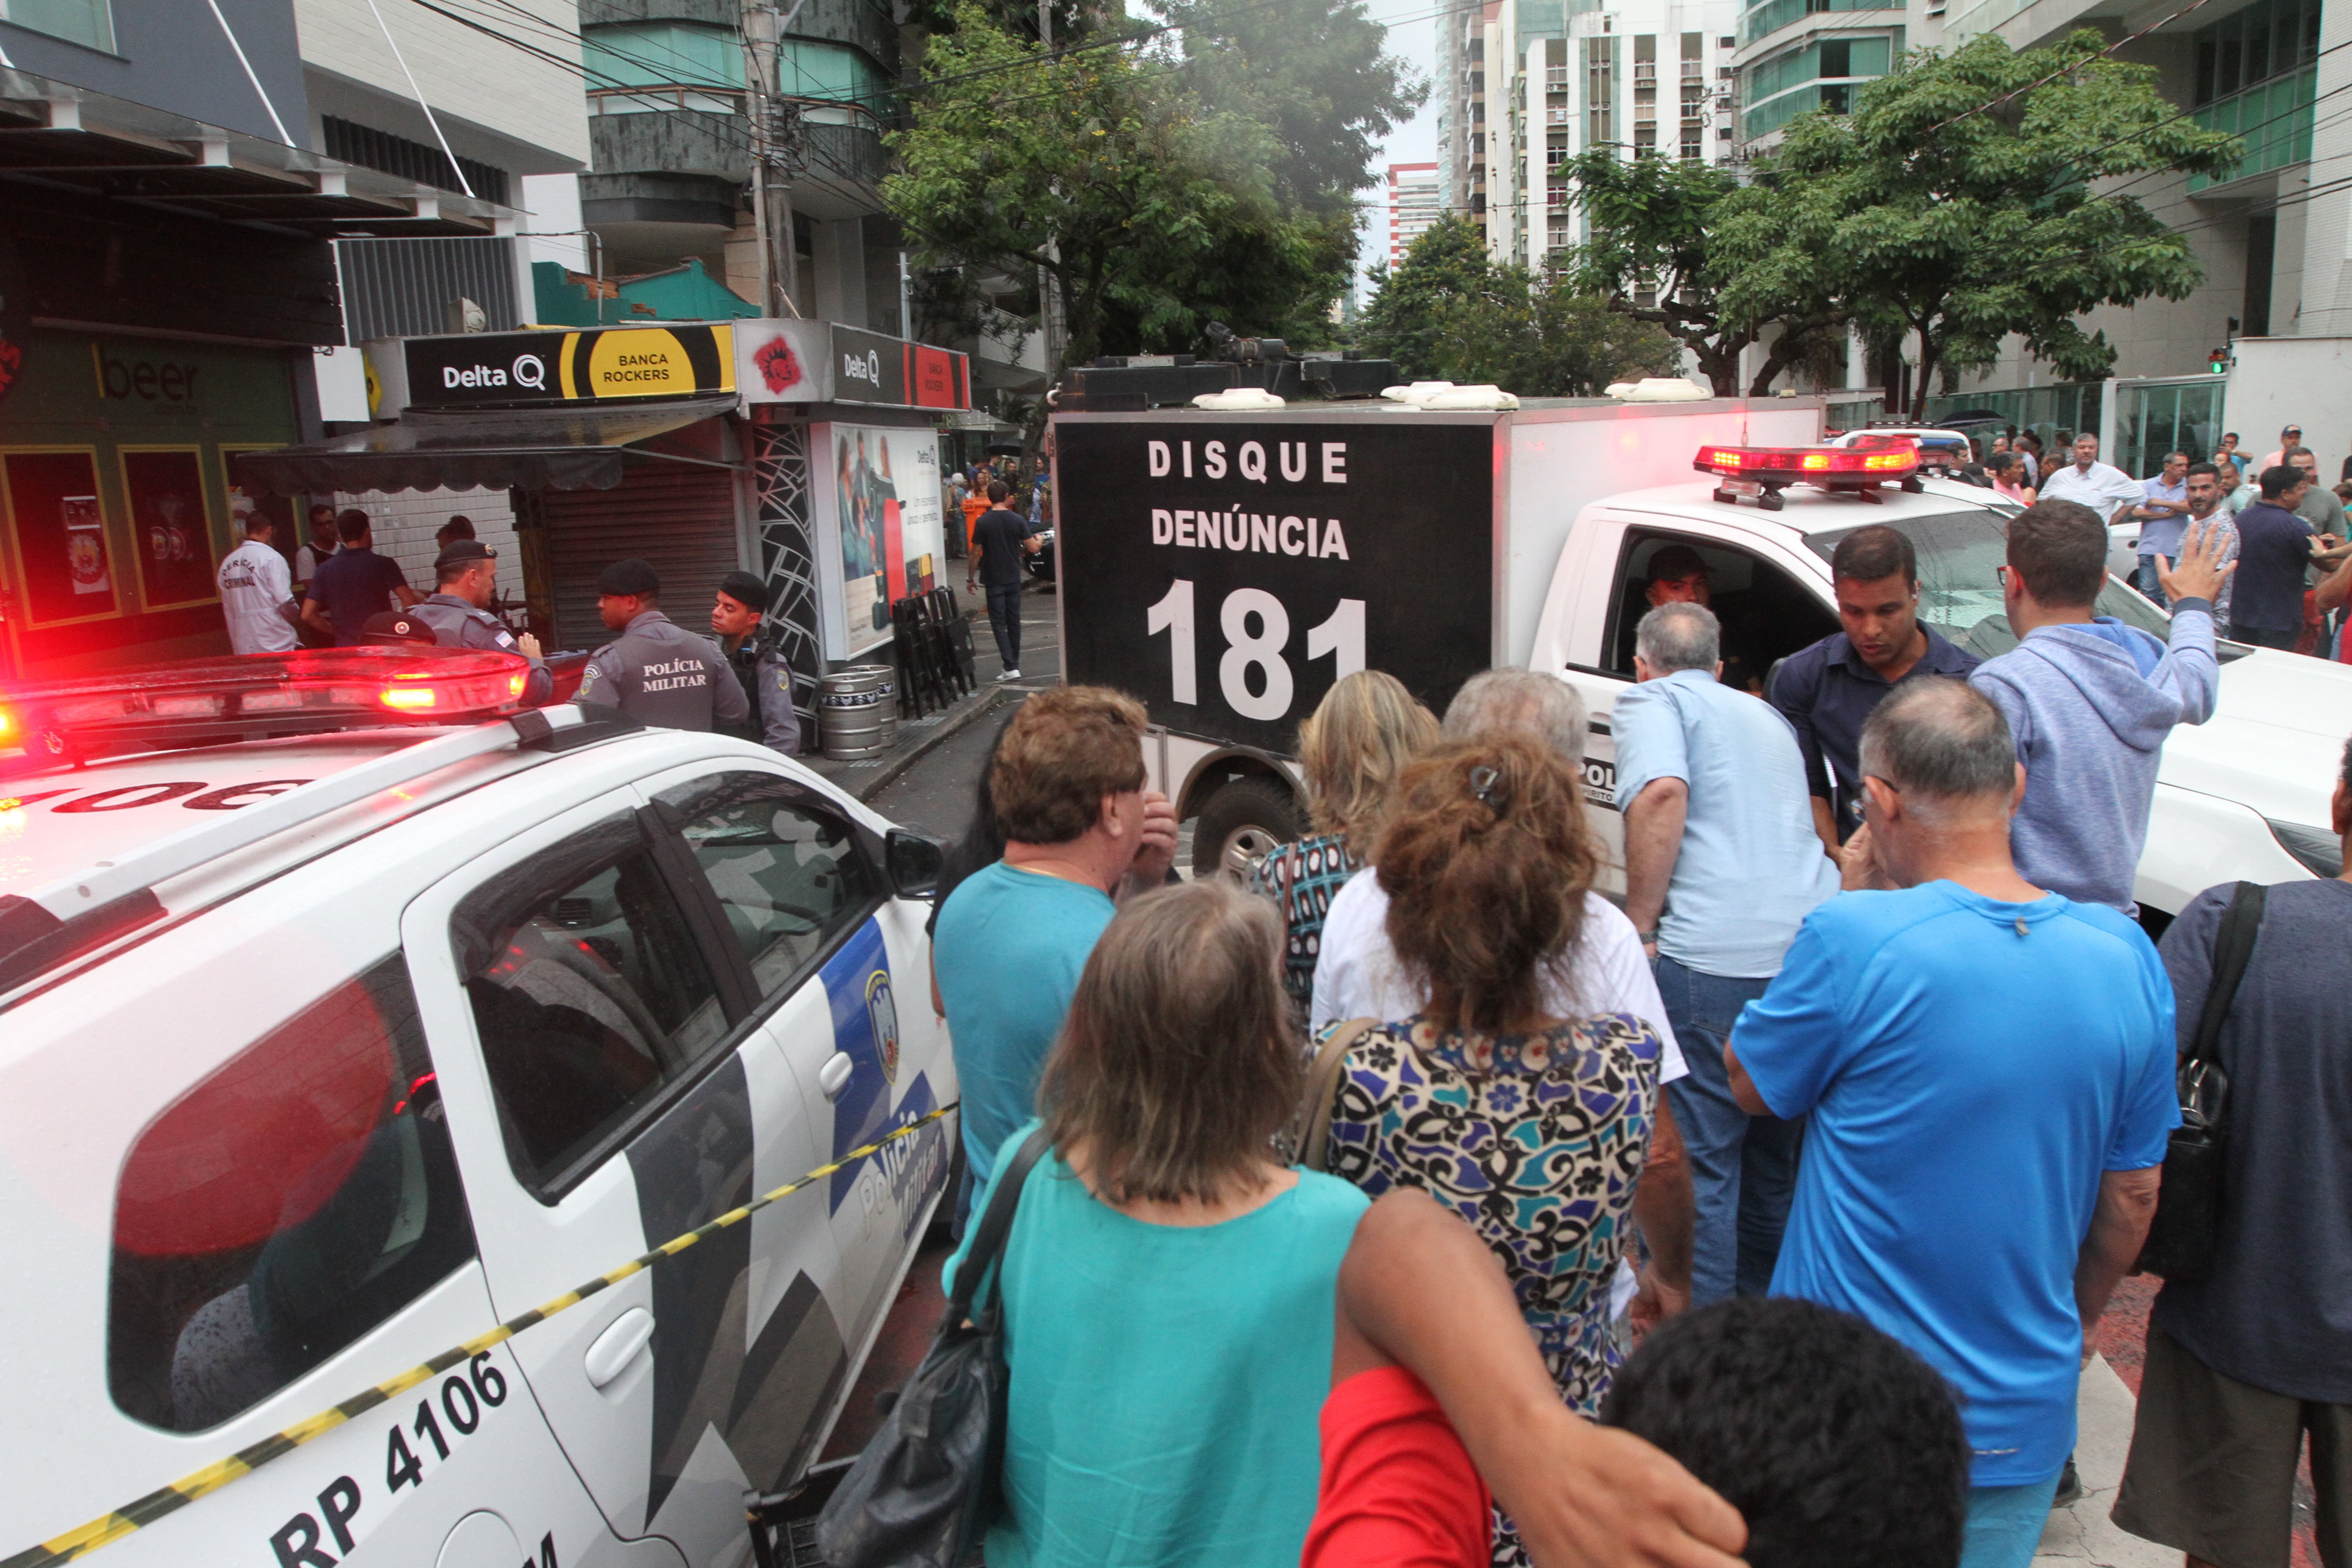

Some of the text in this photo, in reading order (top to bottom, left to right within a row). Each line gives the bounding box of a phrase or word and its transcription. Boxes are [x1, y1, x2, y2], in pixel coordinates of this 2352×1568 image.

[92, 343, 197, 401] beer
[443, 354, 546, 391] Delta Q
[604, 369, 670, 383] ROCKERS
[619, 353, 668, 367] BANCA
[844, 349, 880, 388] Delta Q
[1148, 440, 1347, 484] DISQUE
[1152, 503, 1349, 560] DENÚNCIA
[643, 657, 705, 677] POLÍCIA
[1147, 579, 1366, 721] 181
[642, 674, 707, 693] MILITAR
[1582, 788, 1613, 801] RITO
[269, 1349, 507, 1568] RP 4106
